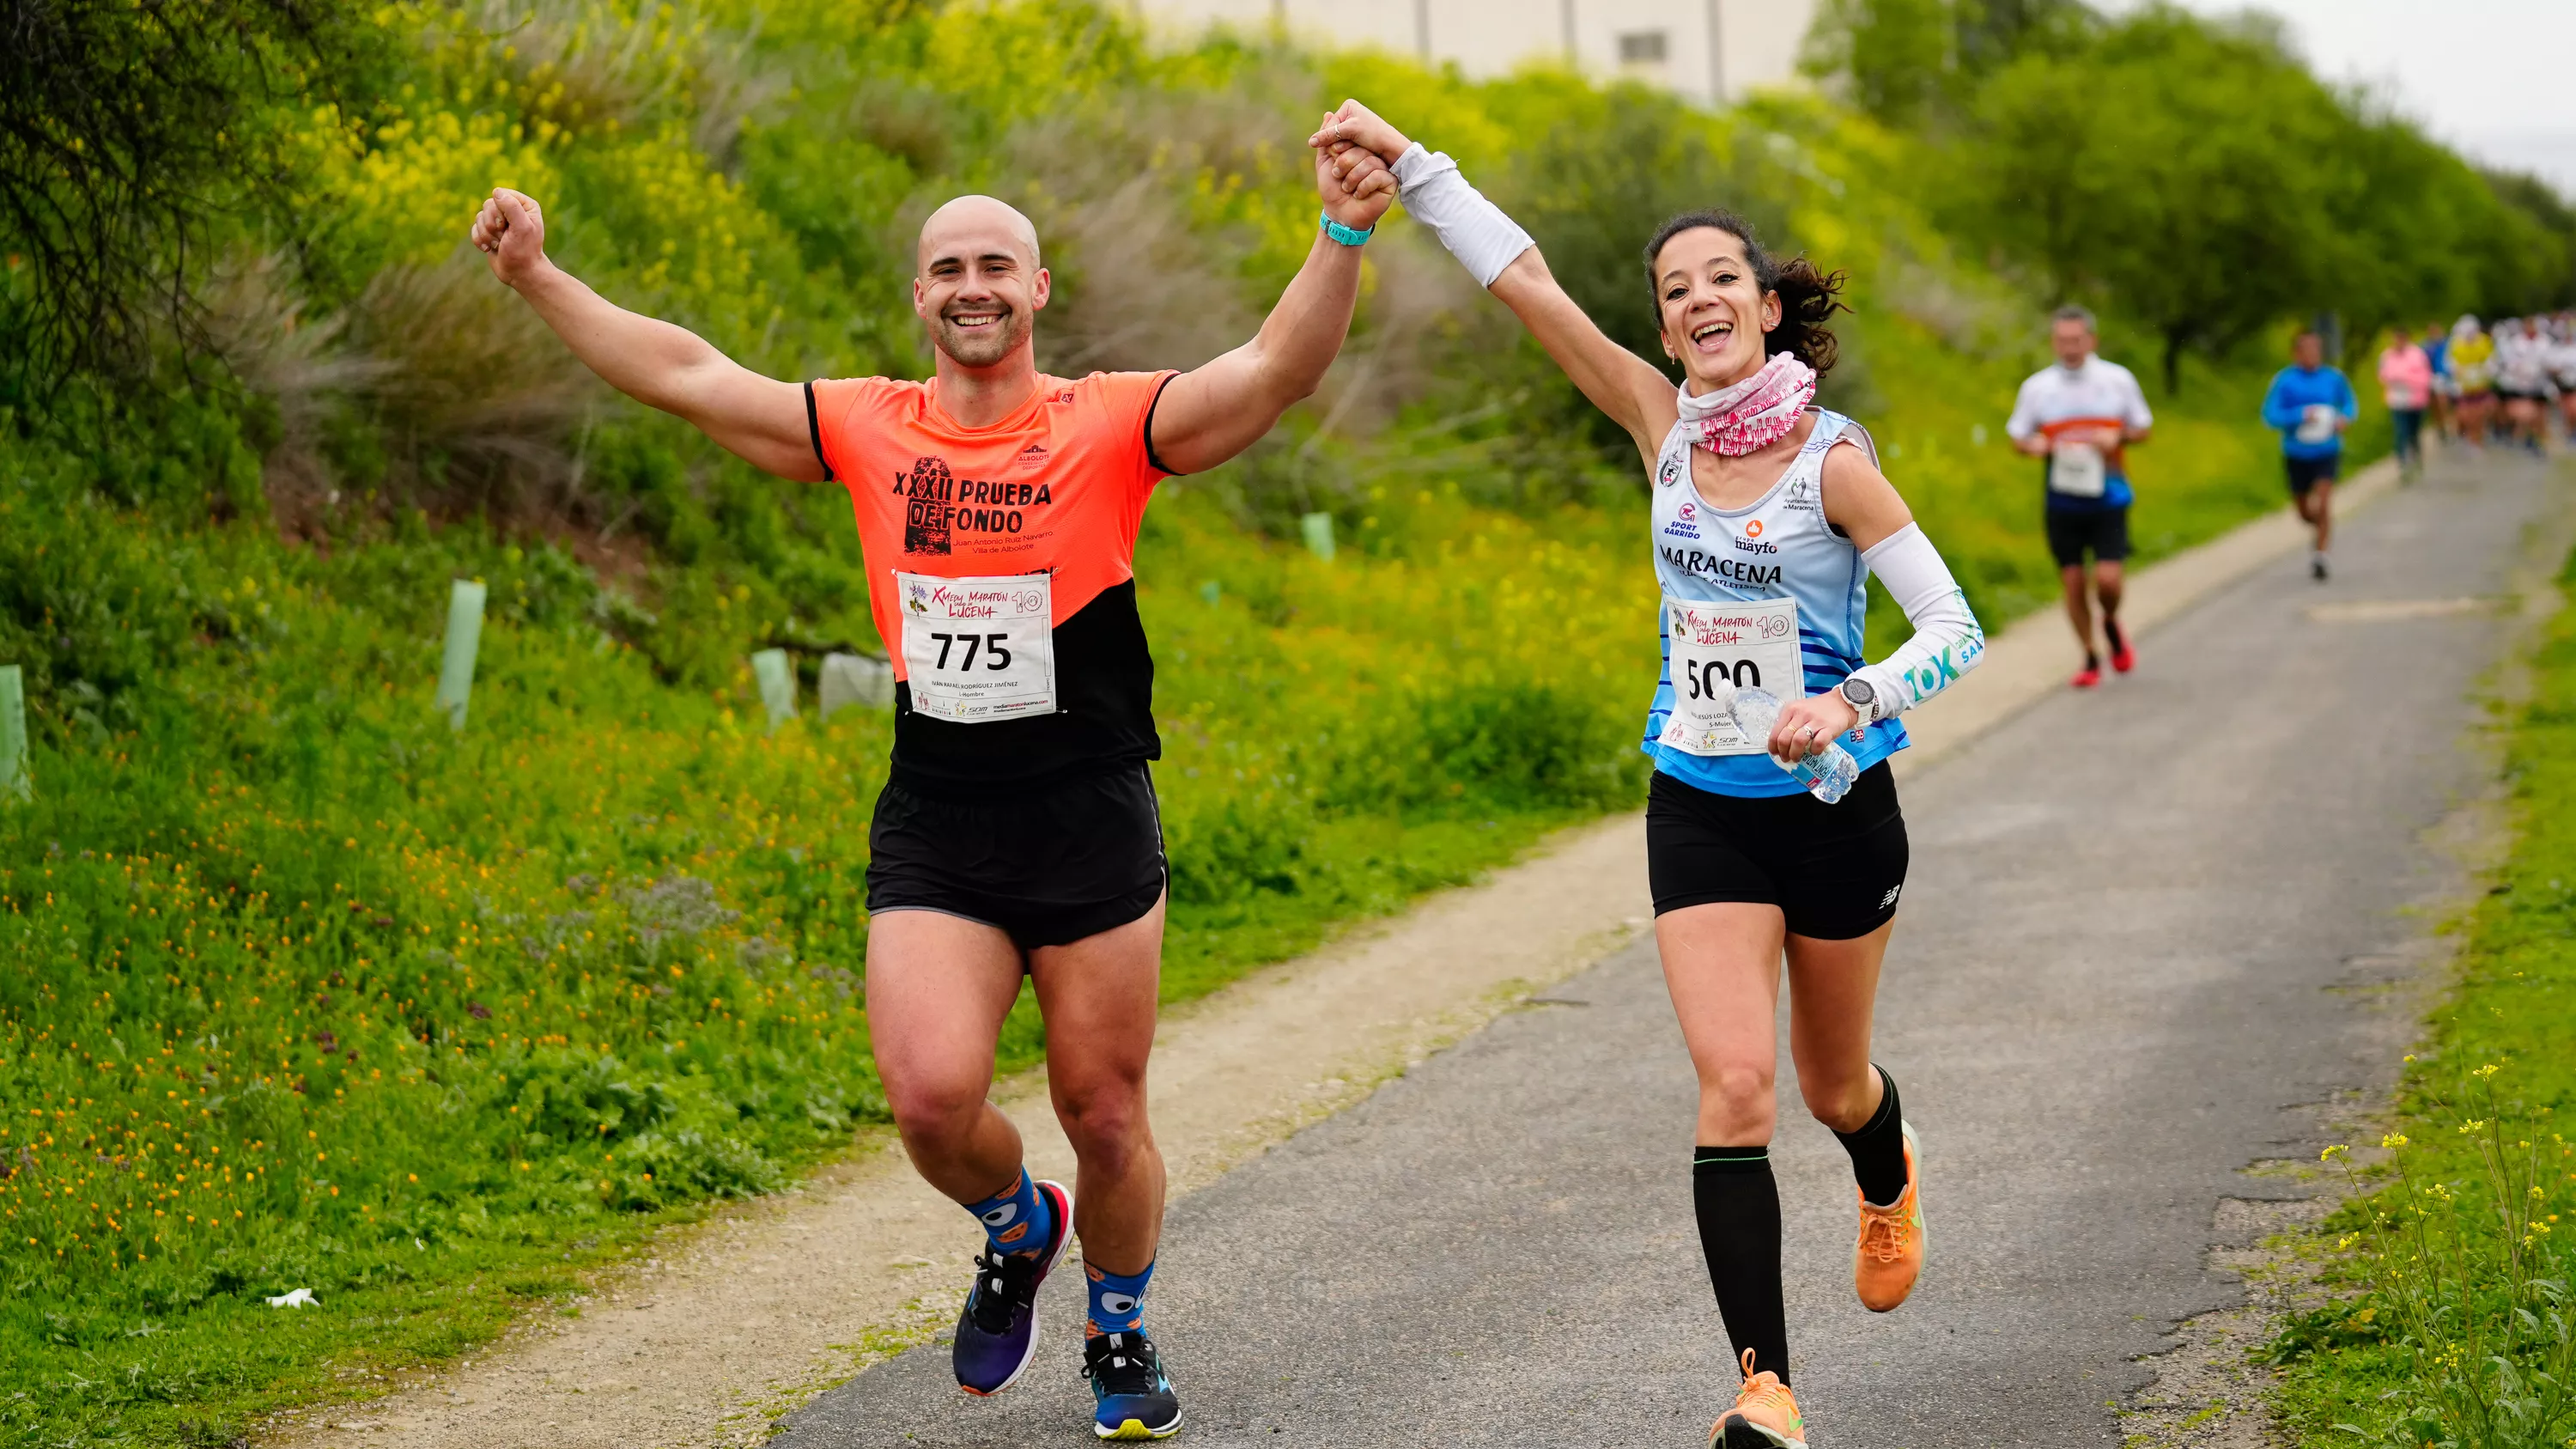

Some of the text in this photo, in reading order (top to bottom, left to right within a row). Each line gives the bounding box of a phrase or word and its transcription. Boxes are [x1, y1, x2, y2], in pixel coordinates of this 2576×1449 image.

[892, 472, 1052, 506] XXXII PRUEBA
[909, 502, 1023, 533] DE FONDO
[1664, 527, 1700, 539] GARRIDO
[1671, 521, 1697, 532] SPORT
[953, 530, 1054, 547] Juan Antonio Ruiz Navarro
[990, 545, 999, 554] de
[1001, 543, 1035, 553] Albolote
[1735, 539, 1777, 556] mayfo
[1660, 544, 1782, 585] MARACENA
[949, 604, 998, 618] LUCENA
[1713, 616, 1753, 628] MARATÓN
[1697, 631, 1745, 645] LUCENA
[932, 633, 1012, 672] 775
[1687, 659, 1761, 701] 500
[993, 700, 1048, 709] mediamaratonlucena.com
